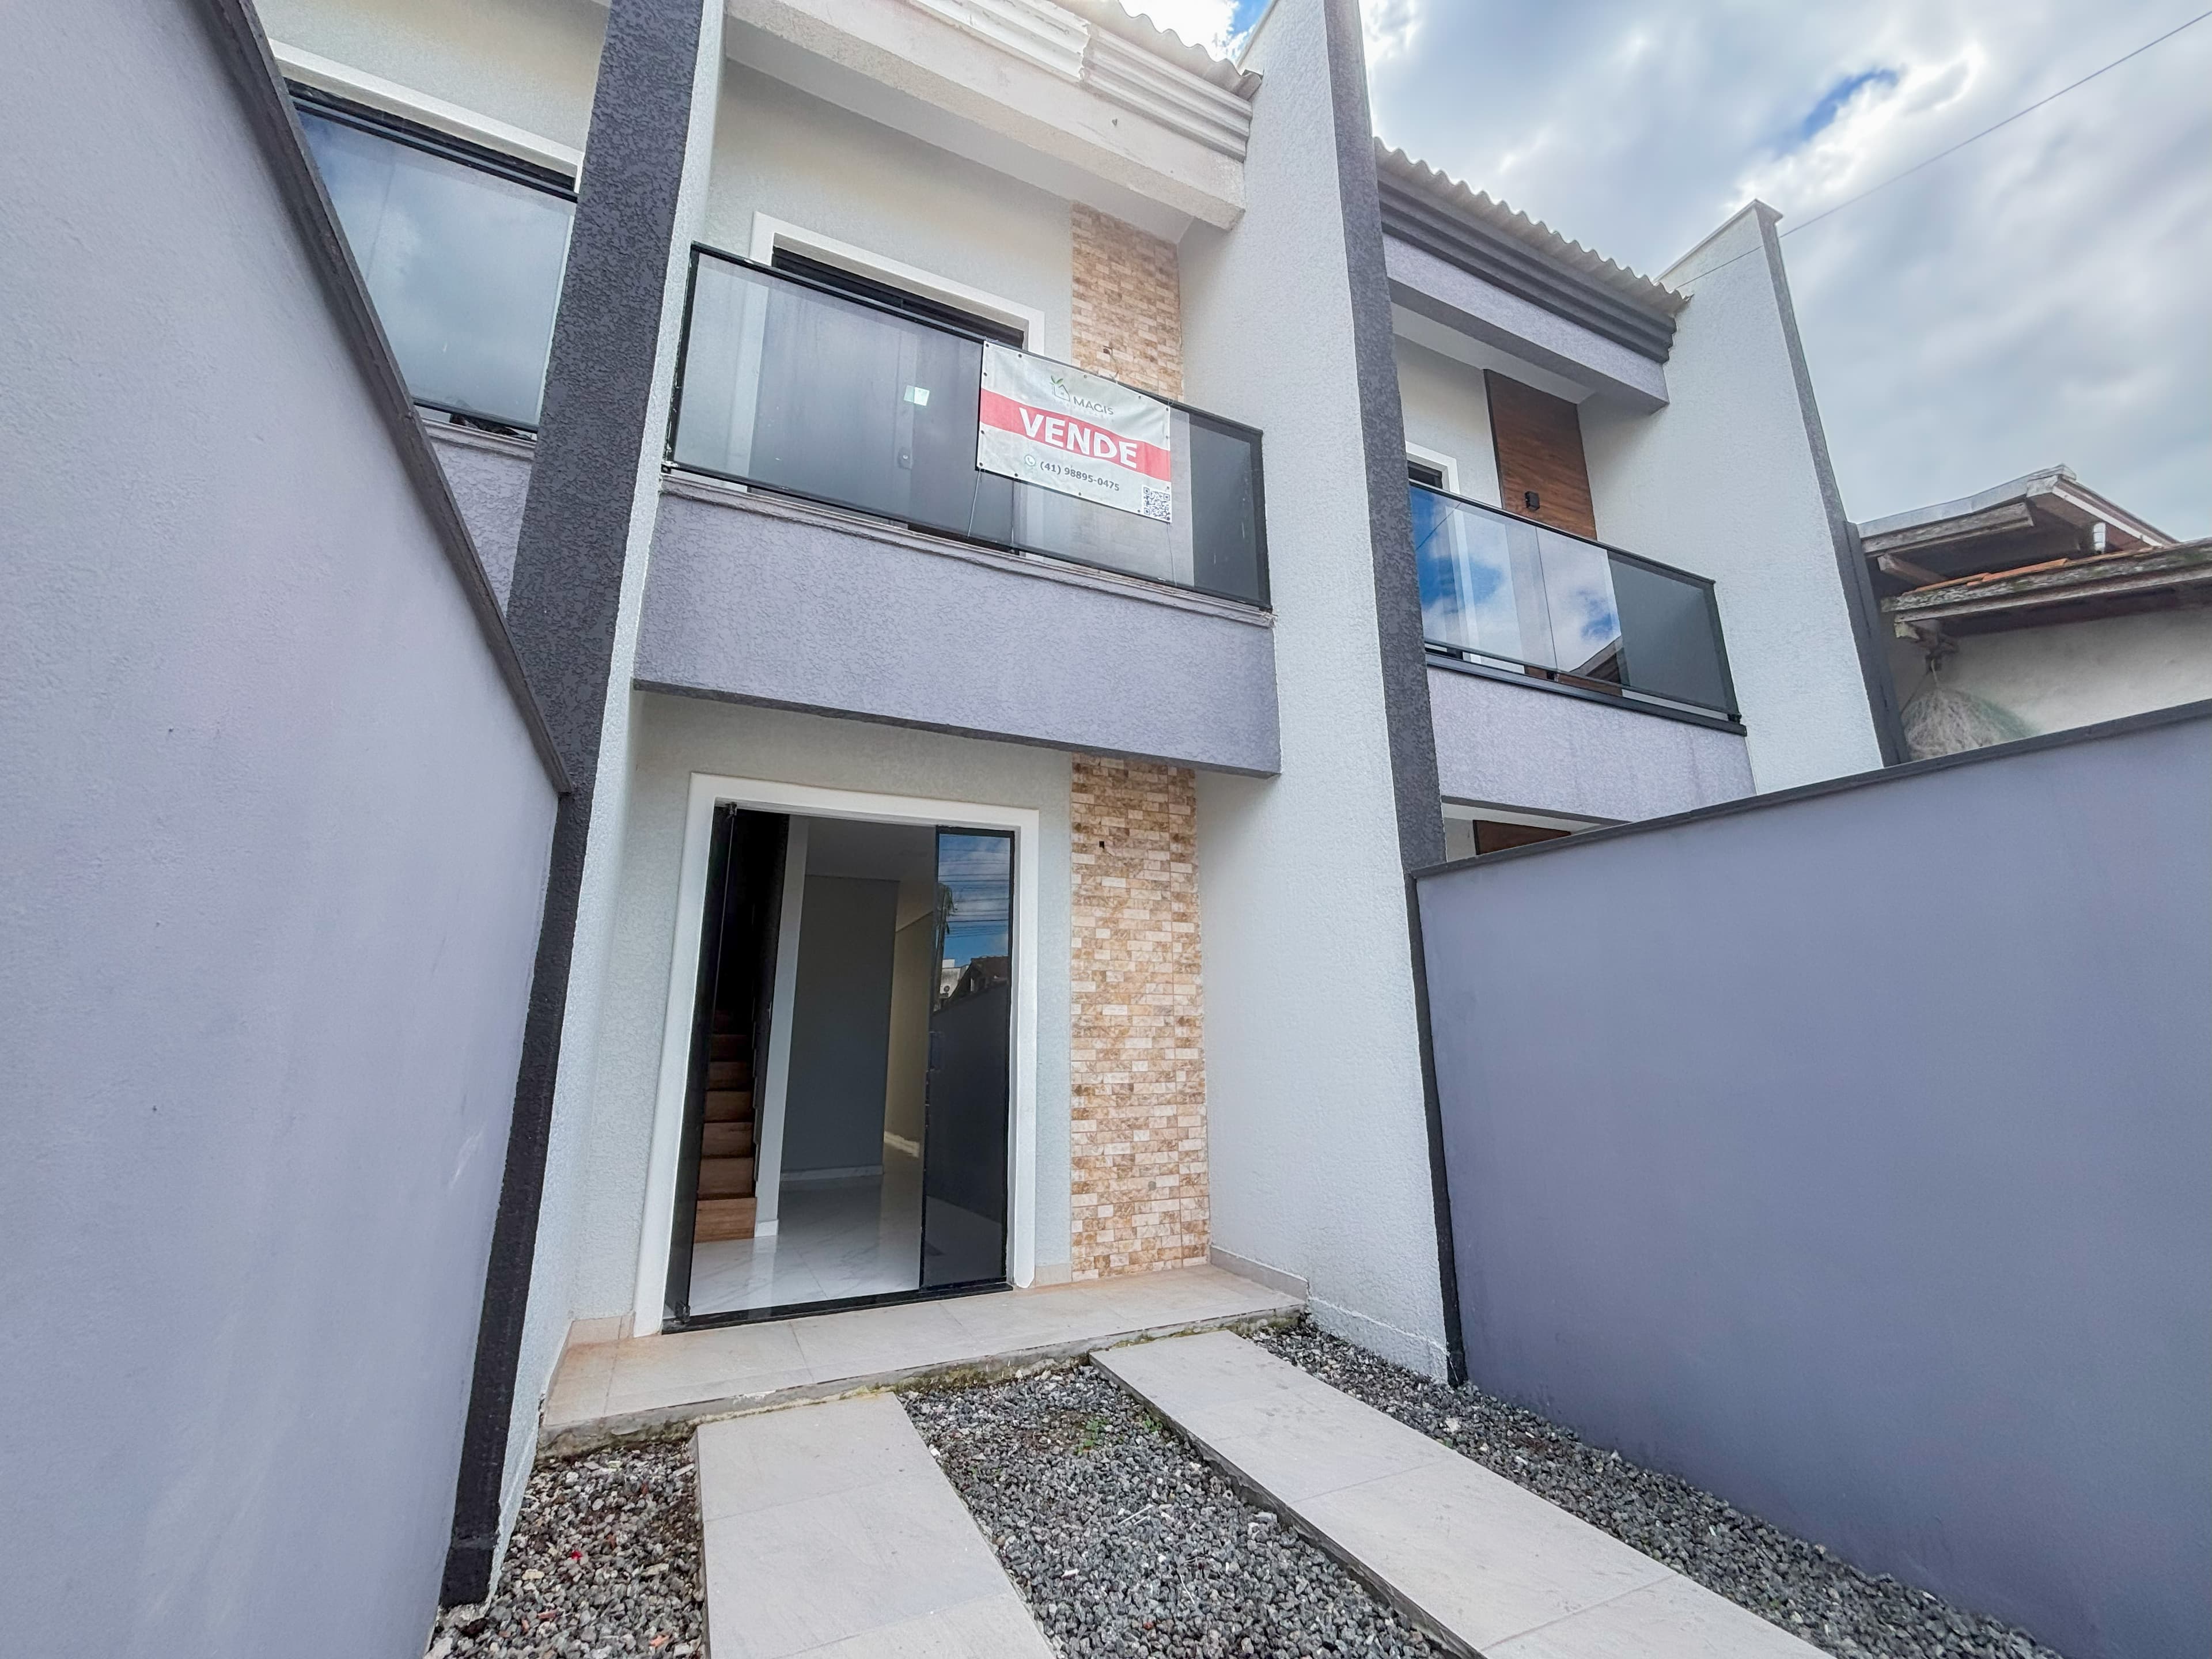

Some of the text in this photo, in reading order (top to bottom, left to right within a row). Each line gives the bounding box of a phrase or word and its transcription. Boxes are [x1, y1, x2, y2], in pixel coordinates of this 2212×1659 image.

[1073, 396, 1114, 415] MAGIS
[1018, 407, 1137, 469] VENDE
[1040, 461, 1120, 491] (41) 98895-0475
